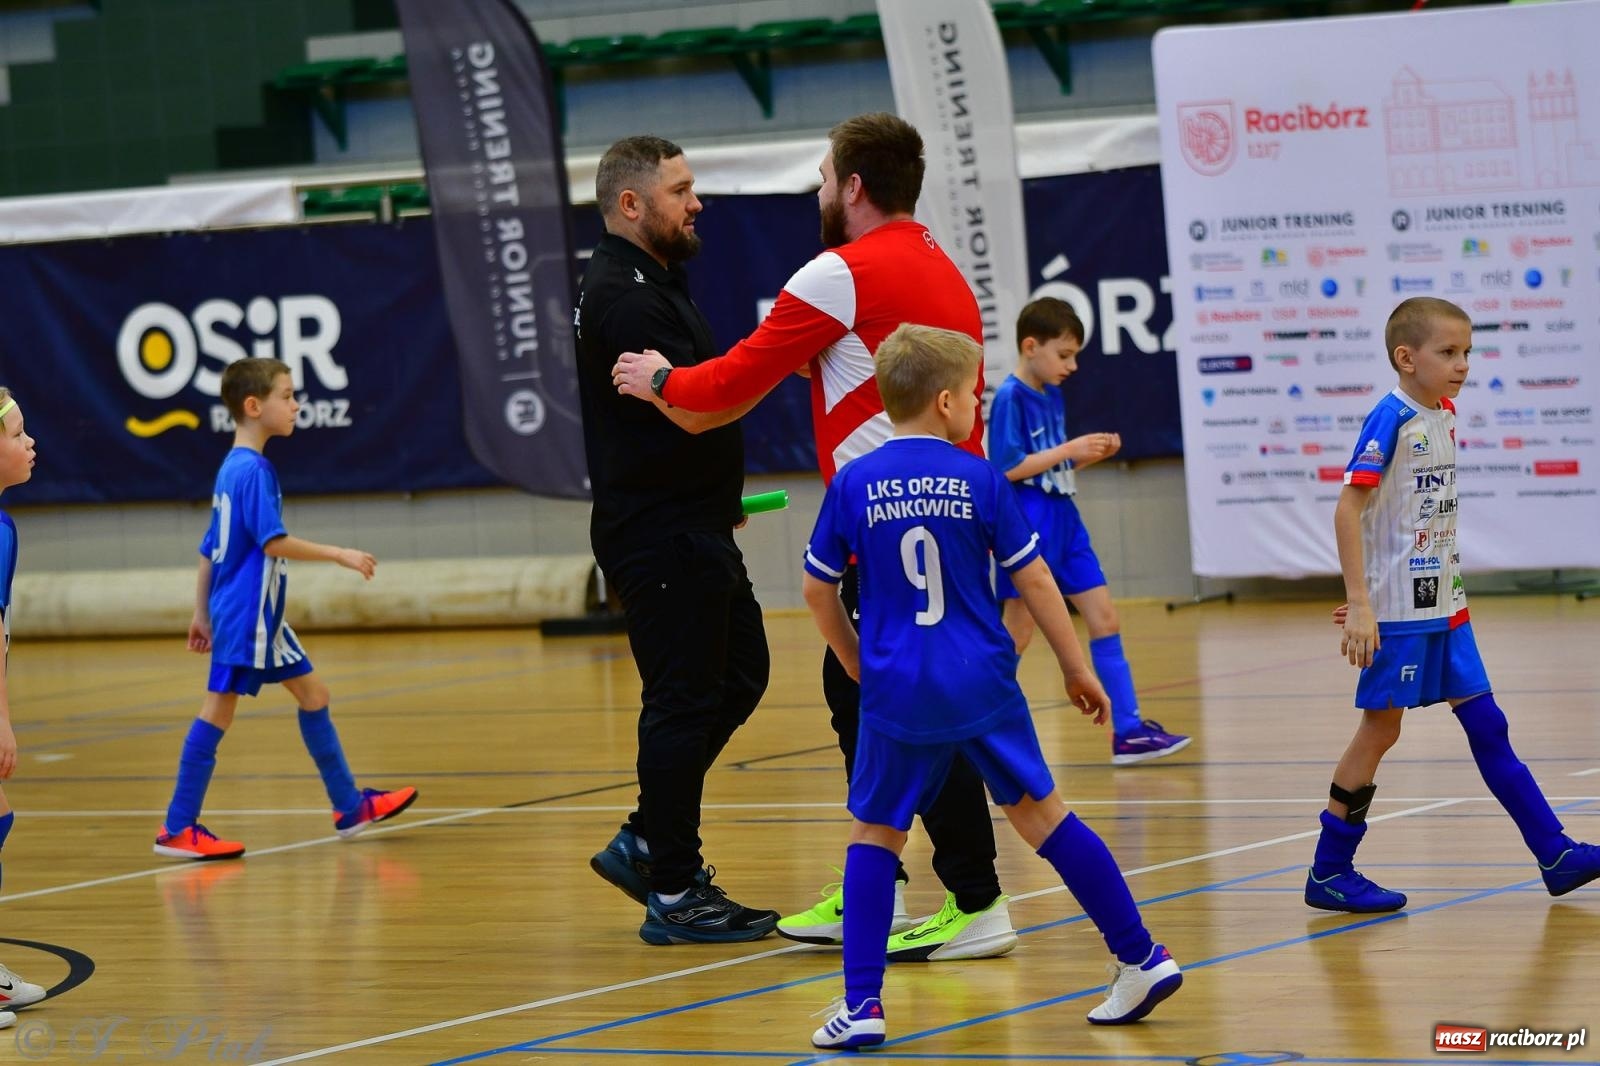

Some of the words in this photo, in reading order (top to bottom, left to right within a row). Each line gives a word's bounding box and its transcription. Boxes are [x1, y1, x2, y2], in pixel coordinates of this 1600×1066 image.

[1245, 101, 1369, 134] Racibórz
[1221, 217, 1278, 233] JUNIOR
[1285, 212, 1355, 229] TRENING
[1425, 206, 1485, 222] JUNIOR
[1491, 201, 1566, 218] TRENING
[117, 295, 348, 399] OSiR
[867, 479, 902, 501] LKS
[908, 477, 971, 498] ORZEŁ
[900, 525, 945, 626] 9
